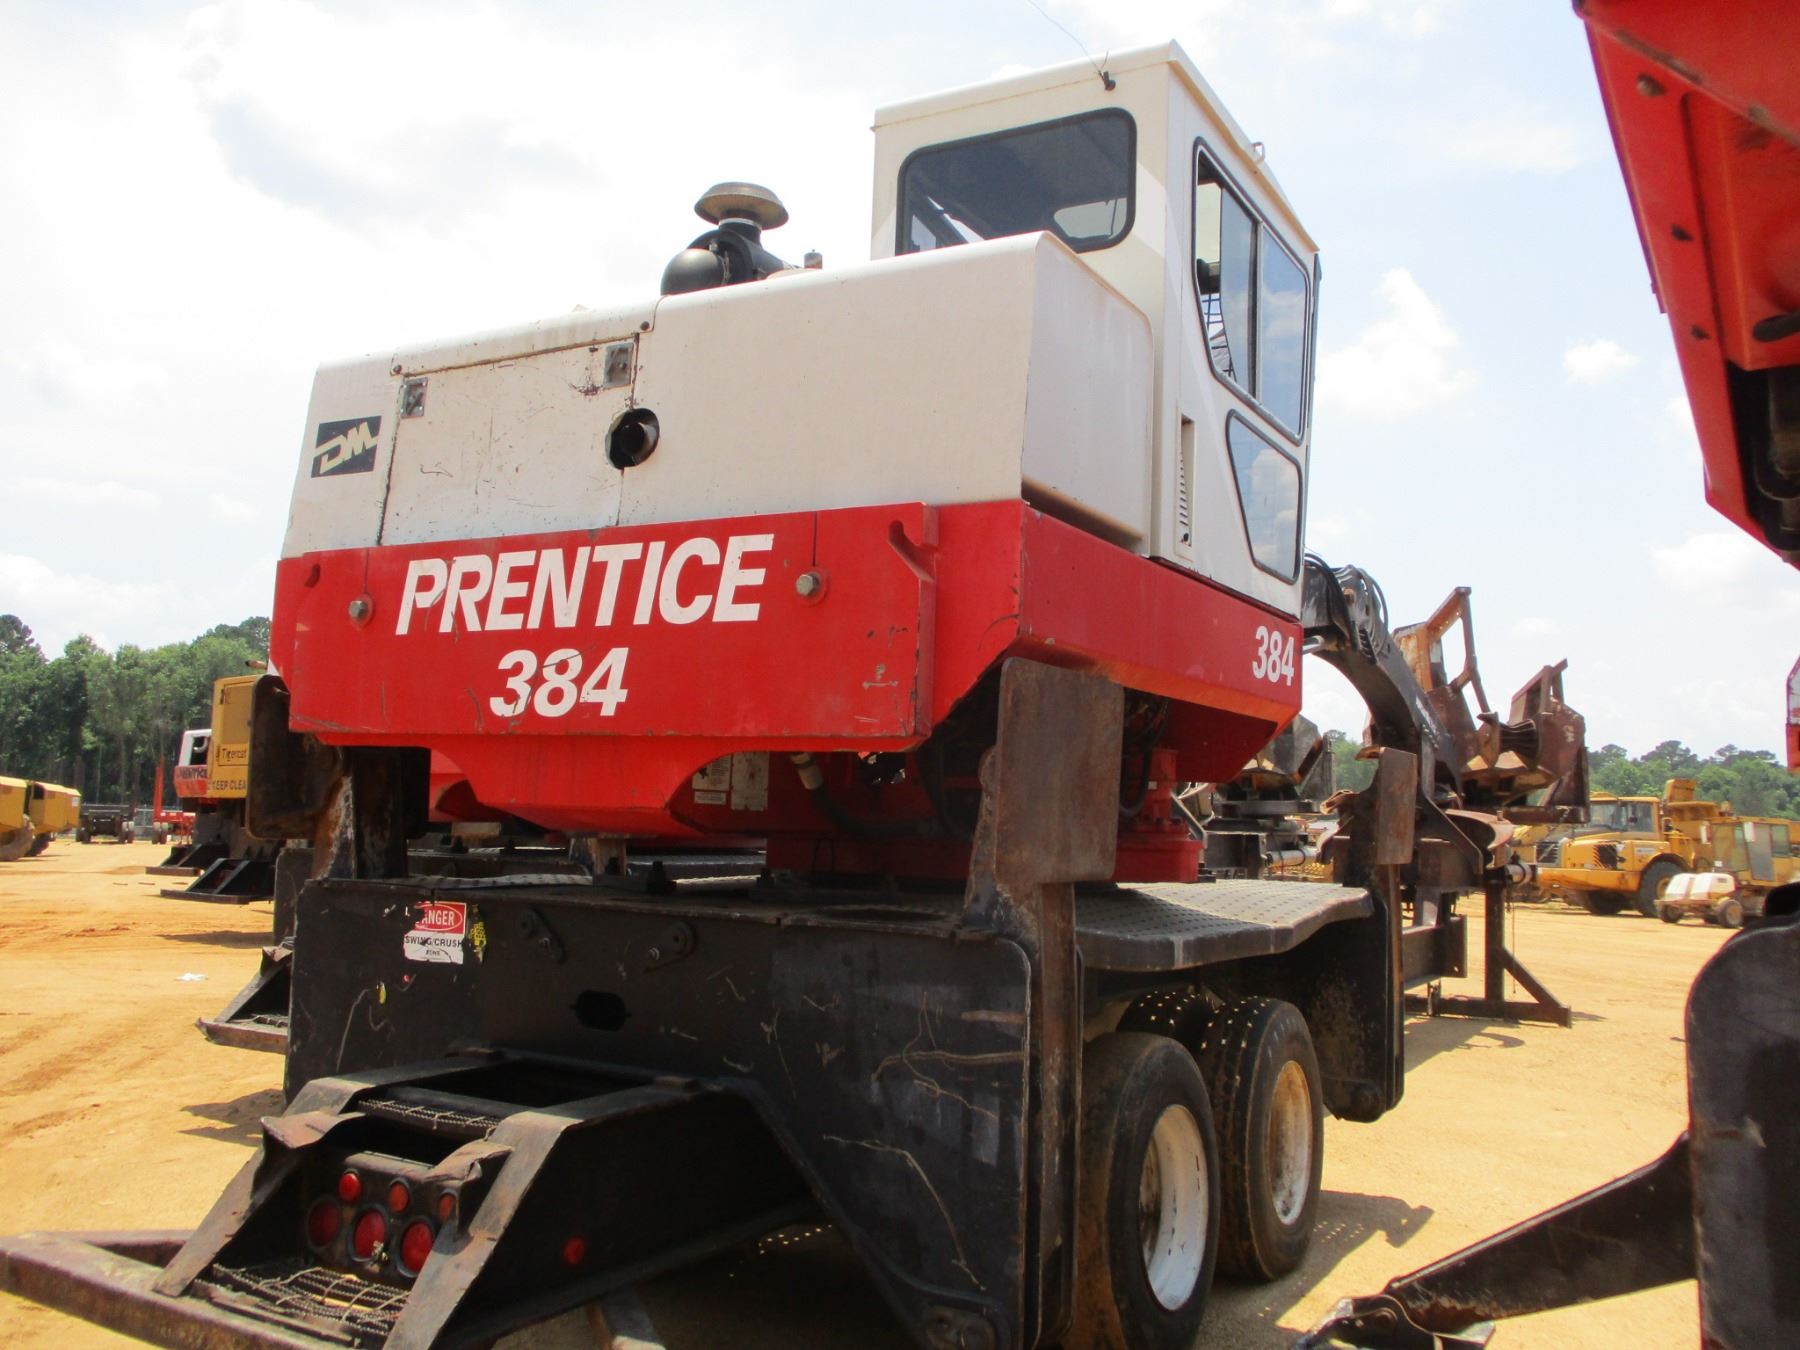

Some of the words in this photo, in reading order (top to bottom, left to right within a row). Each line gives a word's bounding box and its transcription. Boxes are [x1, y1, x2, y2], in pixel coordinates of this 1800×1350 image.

[395, 533, 775, 636] PRENTICE
[489, 646, 630, 718] 384
[1252, 625, 1295, 687] 384
[420, 908, 455, 926] ANGER
